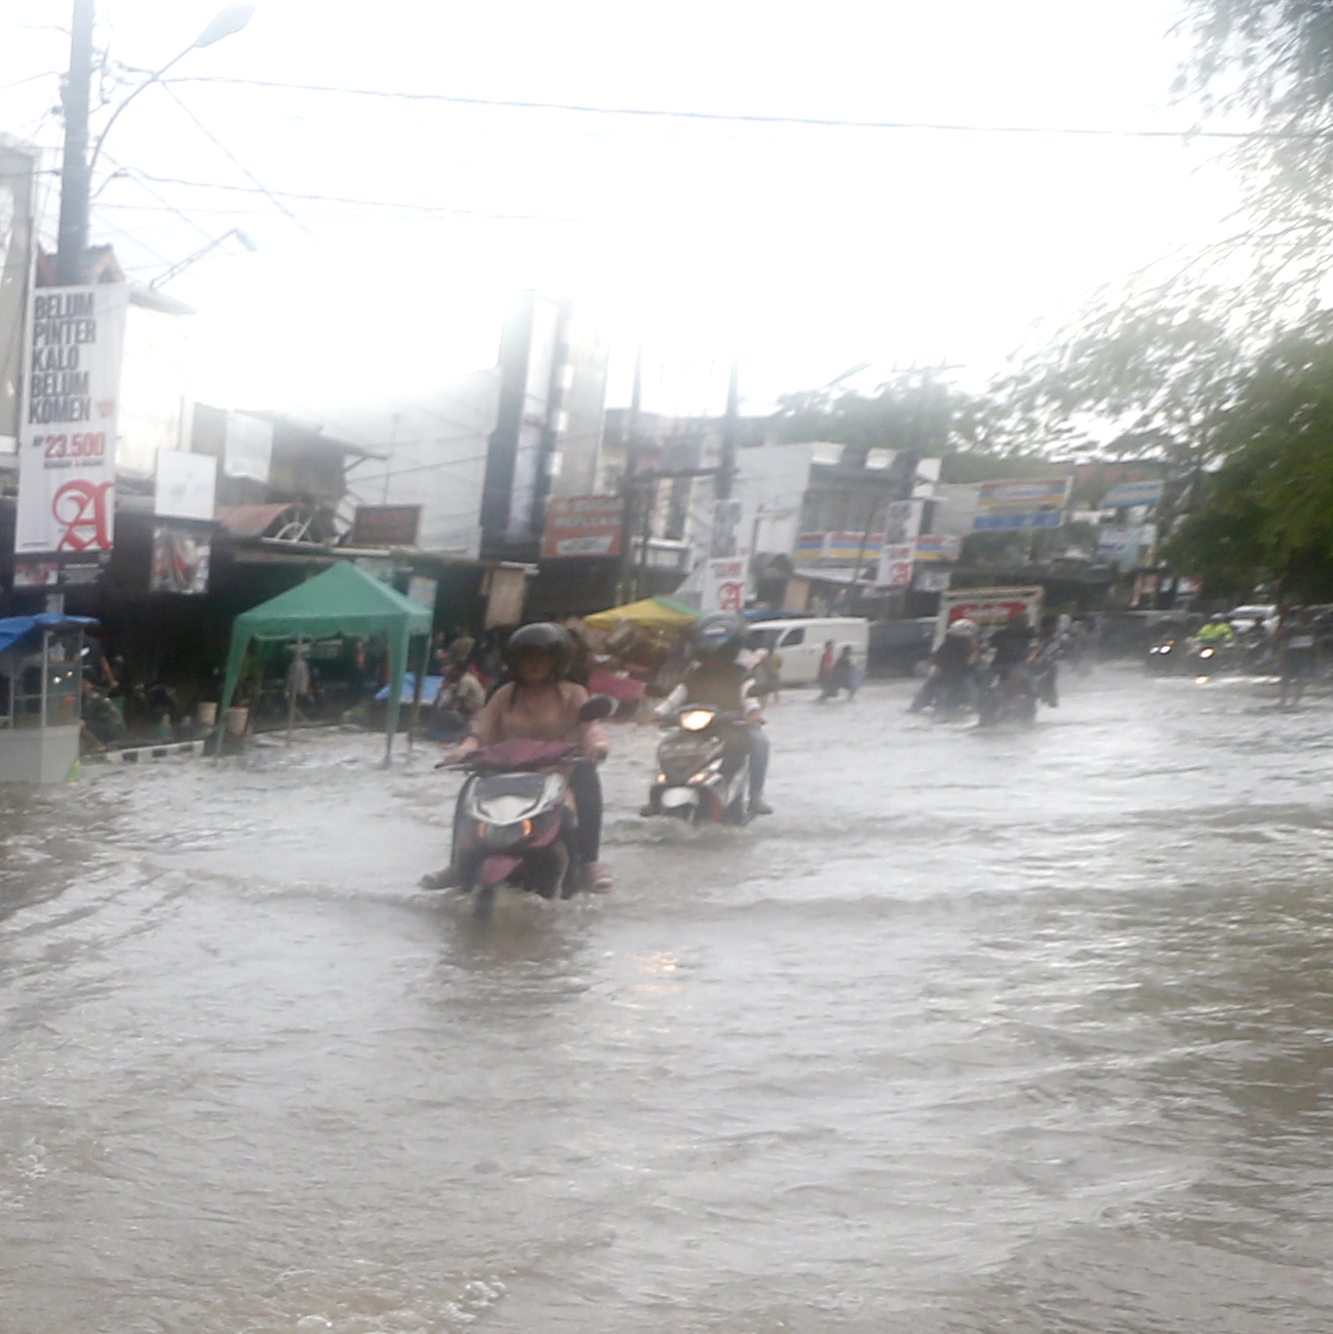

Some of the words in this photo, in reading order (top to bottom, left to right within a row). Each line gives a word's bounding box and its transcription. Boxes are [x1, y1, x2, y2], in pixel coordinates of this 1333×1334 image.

[34, 292, 94, 320] BELUM
[33, 318, 97, 347] PINTER
[32, 344, 79, 373] KALO
[31, 369, 90, 399] BELUM
[28, 396, 92, 425] KOMEN
[44, 432, 106, 459] 23.500
